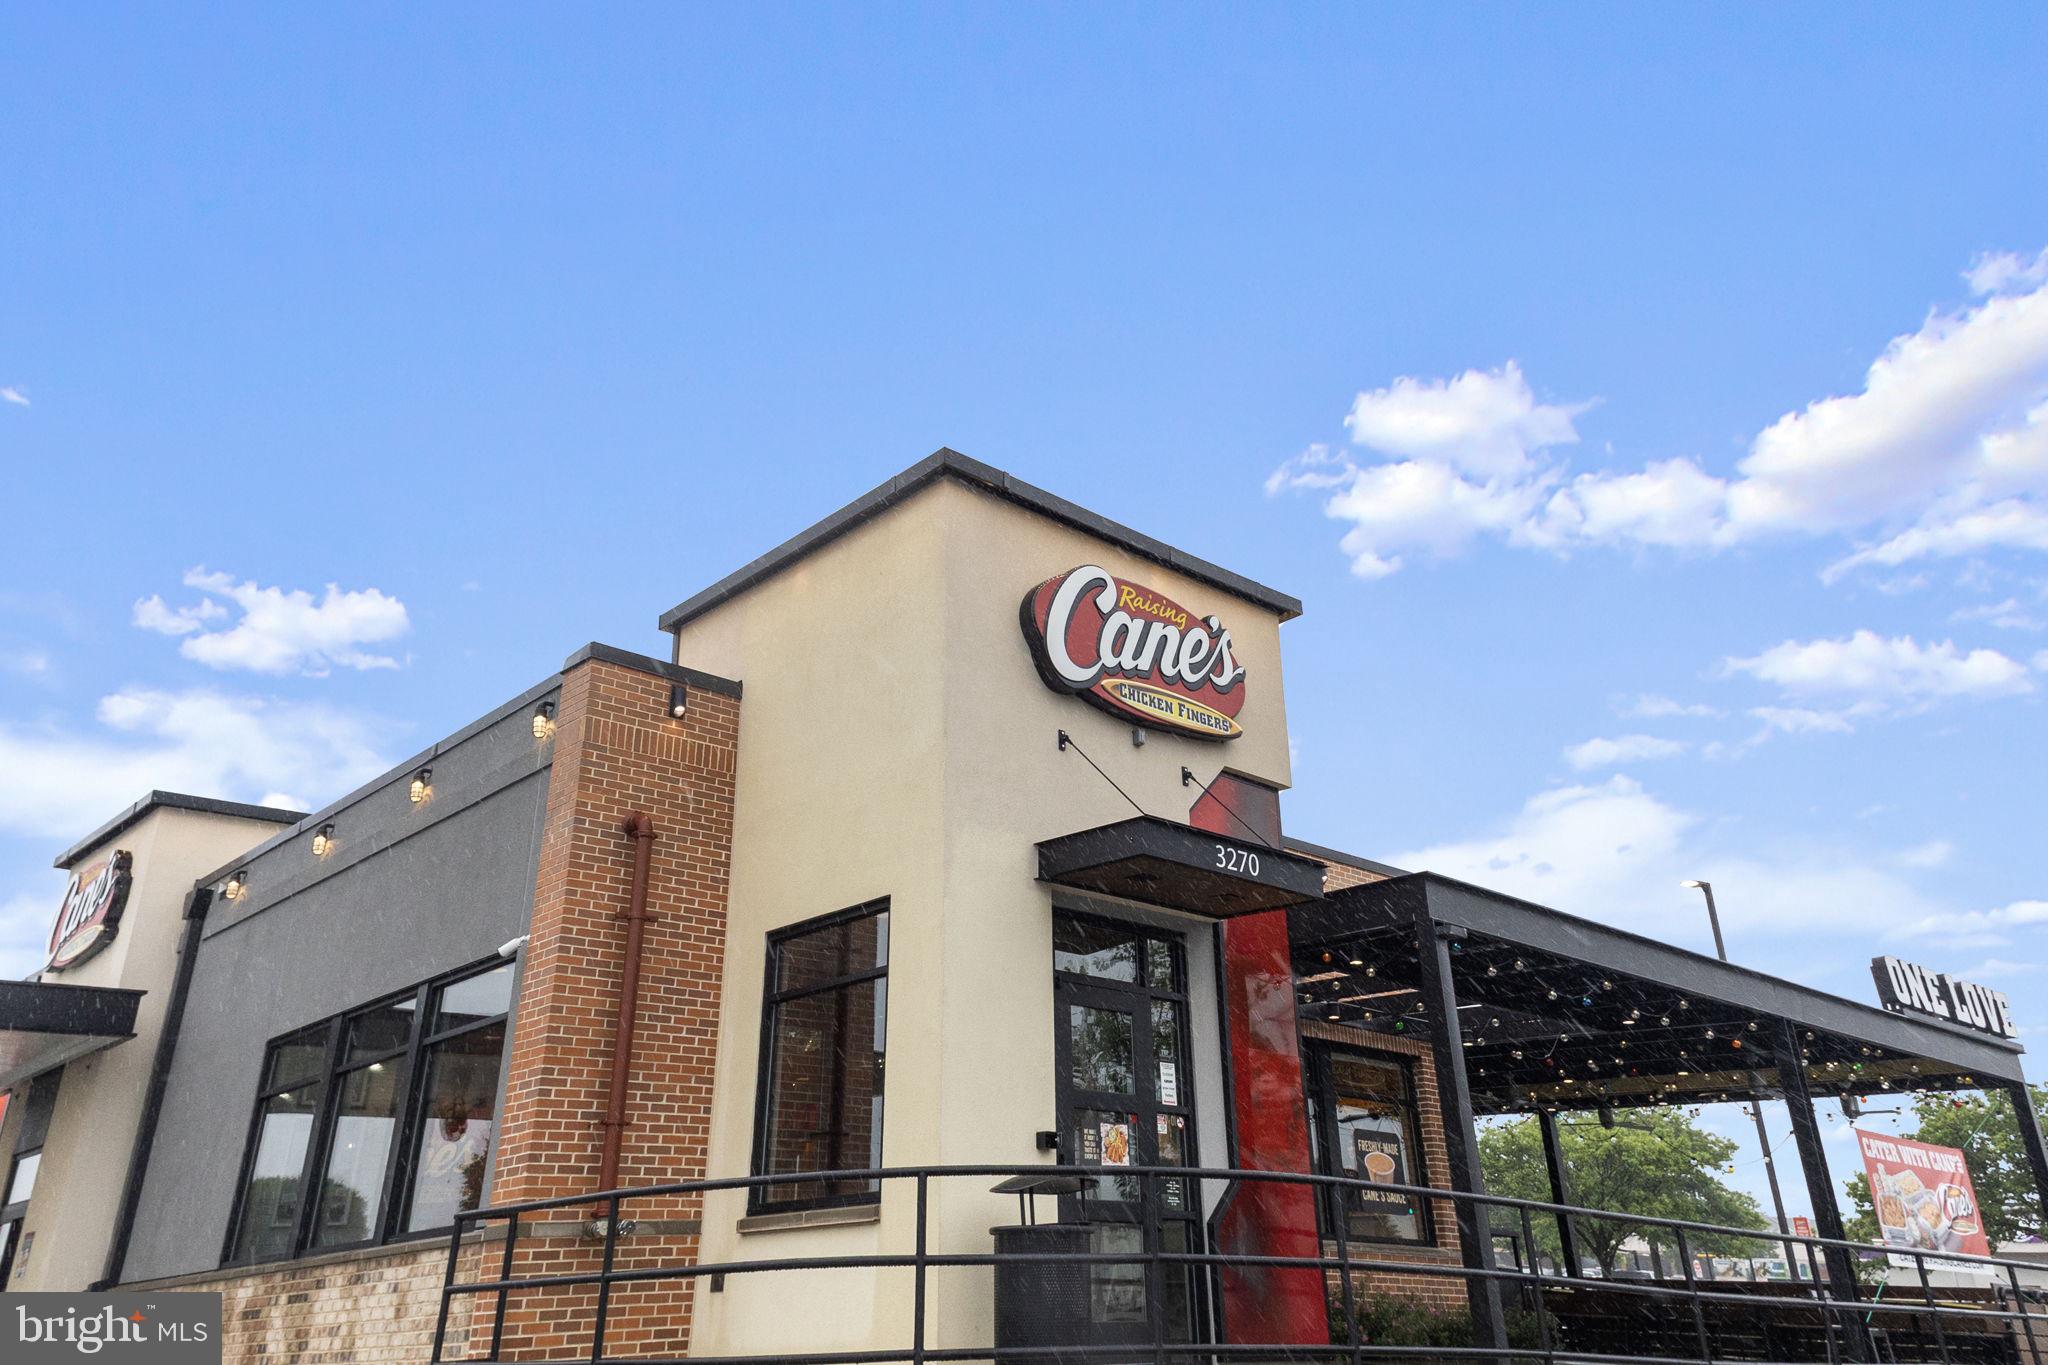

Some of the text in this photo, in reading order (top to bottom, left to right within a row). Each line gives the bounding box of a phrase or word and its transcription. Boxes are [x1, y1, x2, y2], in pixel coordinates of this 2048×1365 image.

[1046, 564, 1245, 686] Cane's
[1119, 585, 1188, 631] Raising
[1119, 683, 1230, 733] CHICKEN FINGERS
[1216, 845, 1259, 876] 3270
[1884, 956, 2018, 1038] ONE LOVE
[1862, 1136, 1901, 1163] CATER
[1898, 1145, 1932, 1169] WITH
